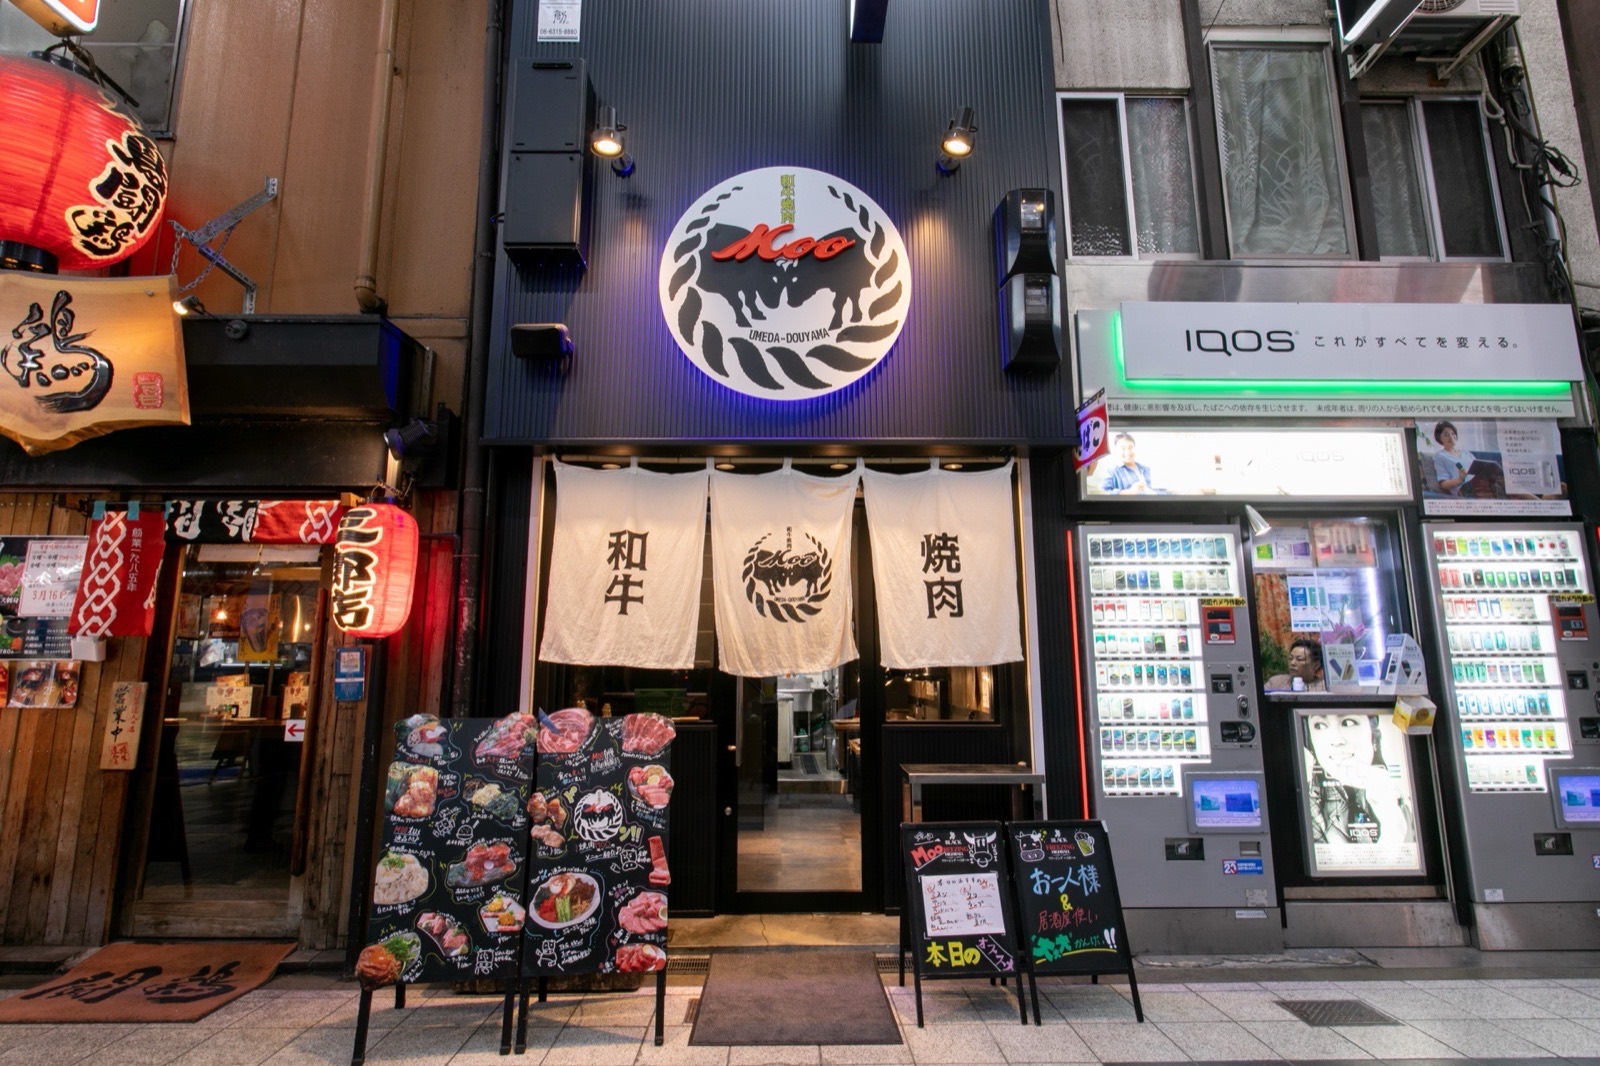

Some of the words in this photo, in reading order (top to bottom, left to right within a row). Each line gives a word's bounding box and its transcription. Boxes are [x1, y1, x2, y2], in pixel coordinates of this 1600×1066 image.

[780, 174, 796, 224] 和牛焼肉
[711, 223, 856, 262] Moo
[749, 328, 830, 344] UMEDA-DOUYAMA
[1186, 329, 1295, 357] IQOS
[1313, 335, 1519, 350] これがすべてを変える。
[1509, 468, 1536, 476] IQOS
[604, 528, 649, 616] 和牛
[920, 532, 964, 620] 焼肉
[1350, 828, 1378, 838] IQOS
[911, 845, 943, 868] Moo
[1030, 864, 1102, 897] お一人様
[1060, 893, 1073, 911] &
[925, 941, 981, 967] 本日の
[978, 936, 1014, 971] オススメ
